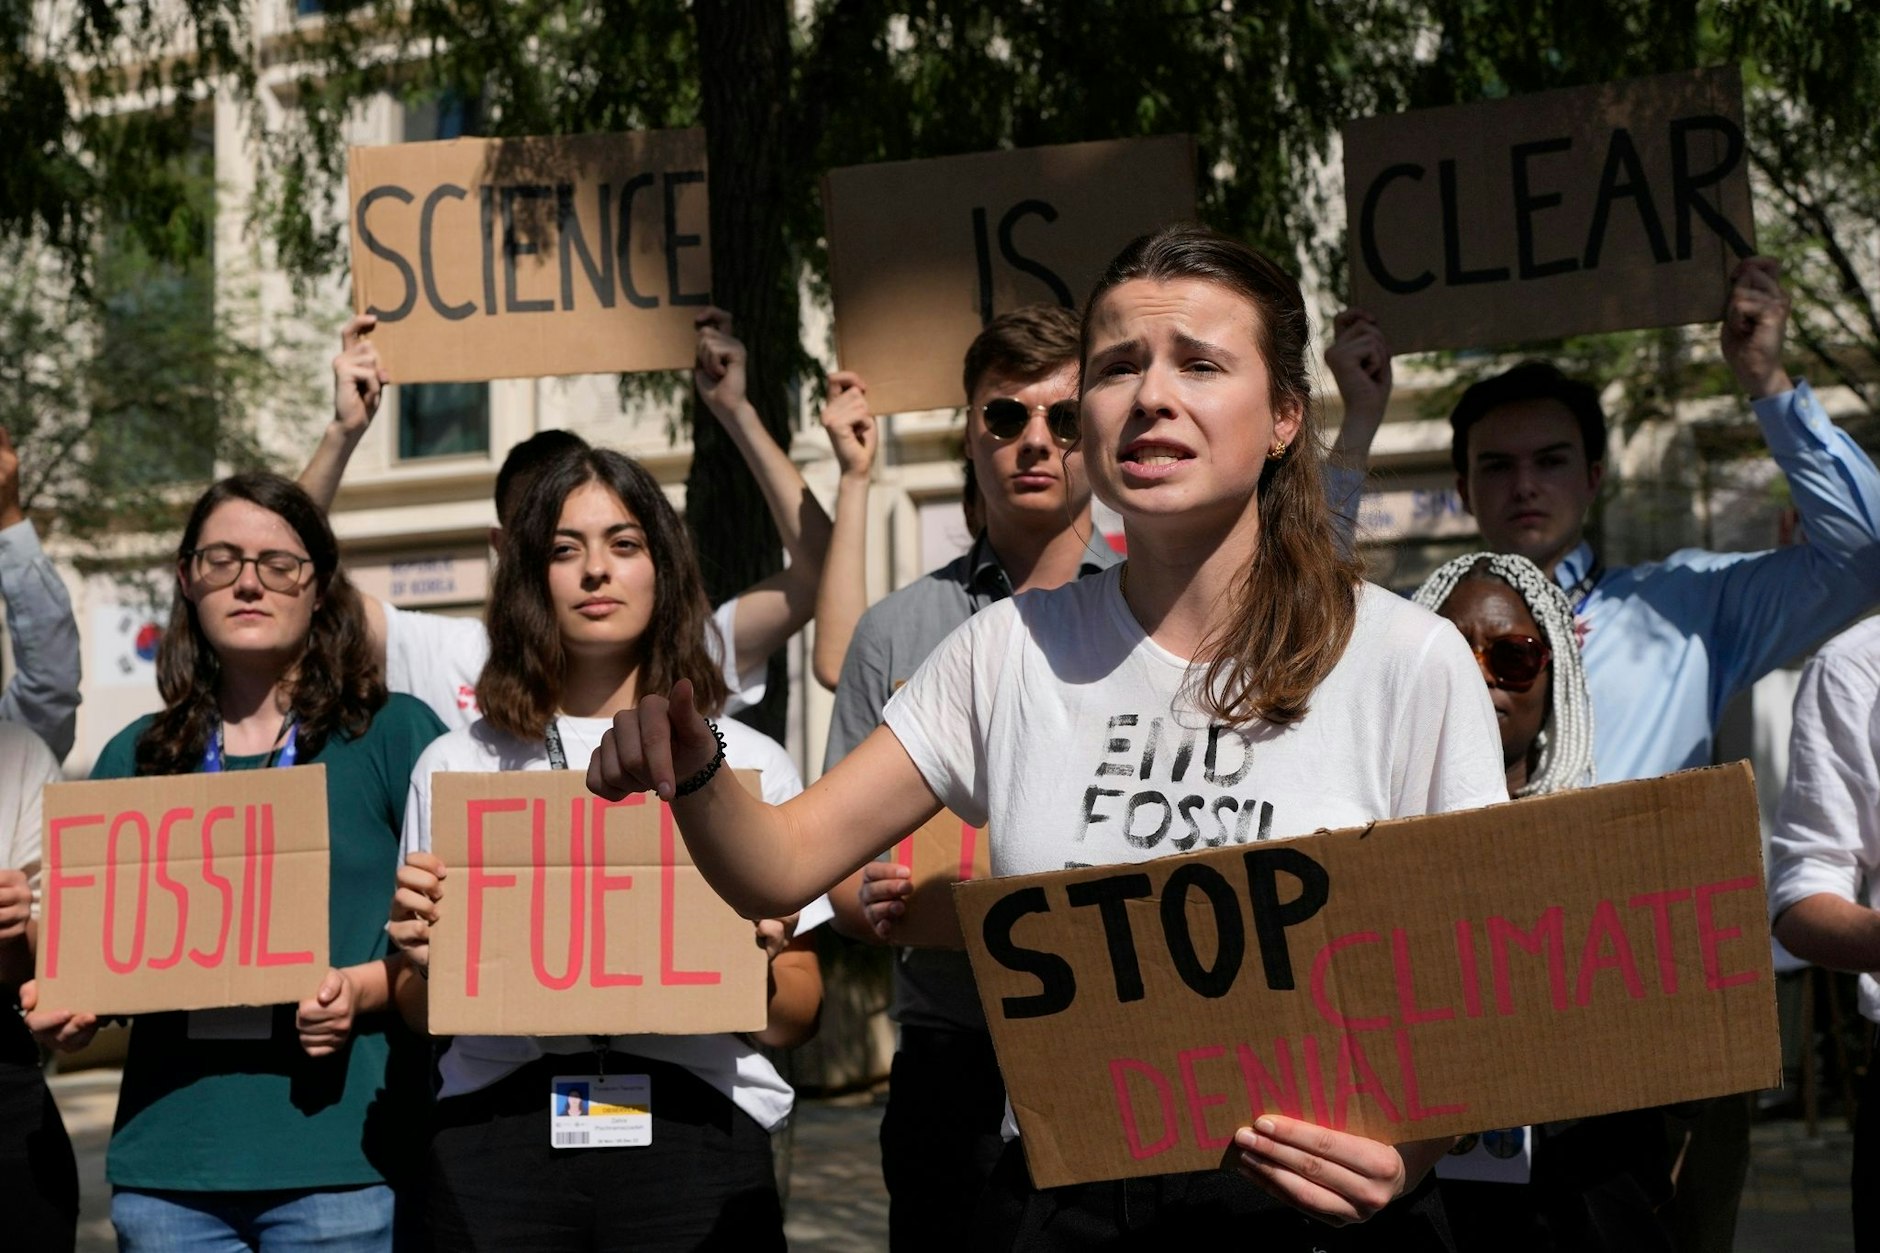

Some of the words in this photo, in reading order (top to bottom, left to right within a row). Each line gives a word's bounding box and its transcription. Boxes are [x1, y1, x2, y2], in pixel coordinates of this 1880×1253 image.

[356, 170, 710, 323] SCIENCE
[972, 199, 1076, 330] IS
[1359, 115, 1758, 295] CLEAR
[1094, 714, 1254, 788] END
[45, 803, 315, 979] FOSSIL
[465, 794, 722, 997] FUEL
[981, 847, 1331, 1020] STOP
[1311, 876, 1762, 1032] CLIMATE
[1109, 1030, 1469, 1161] DENIAL
